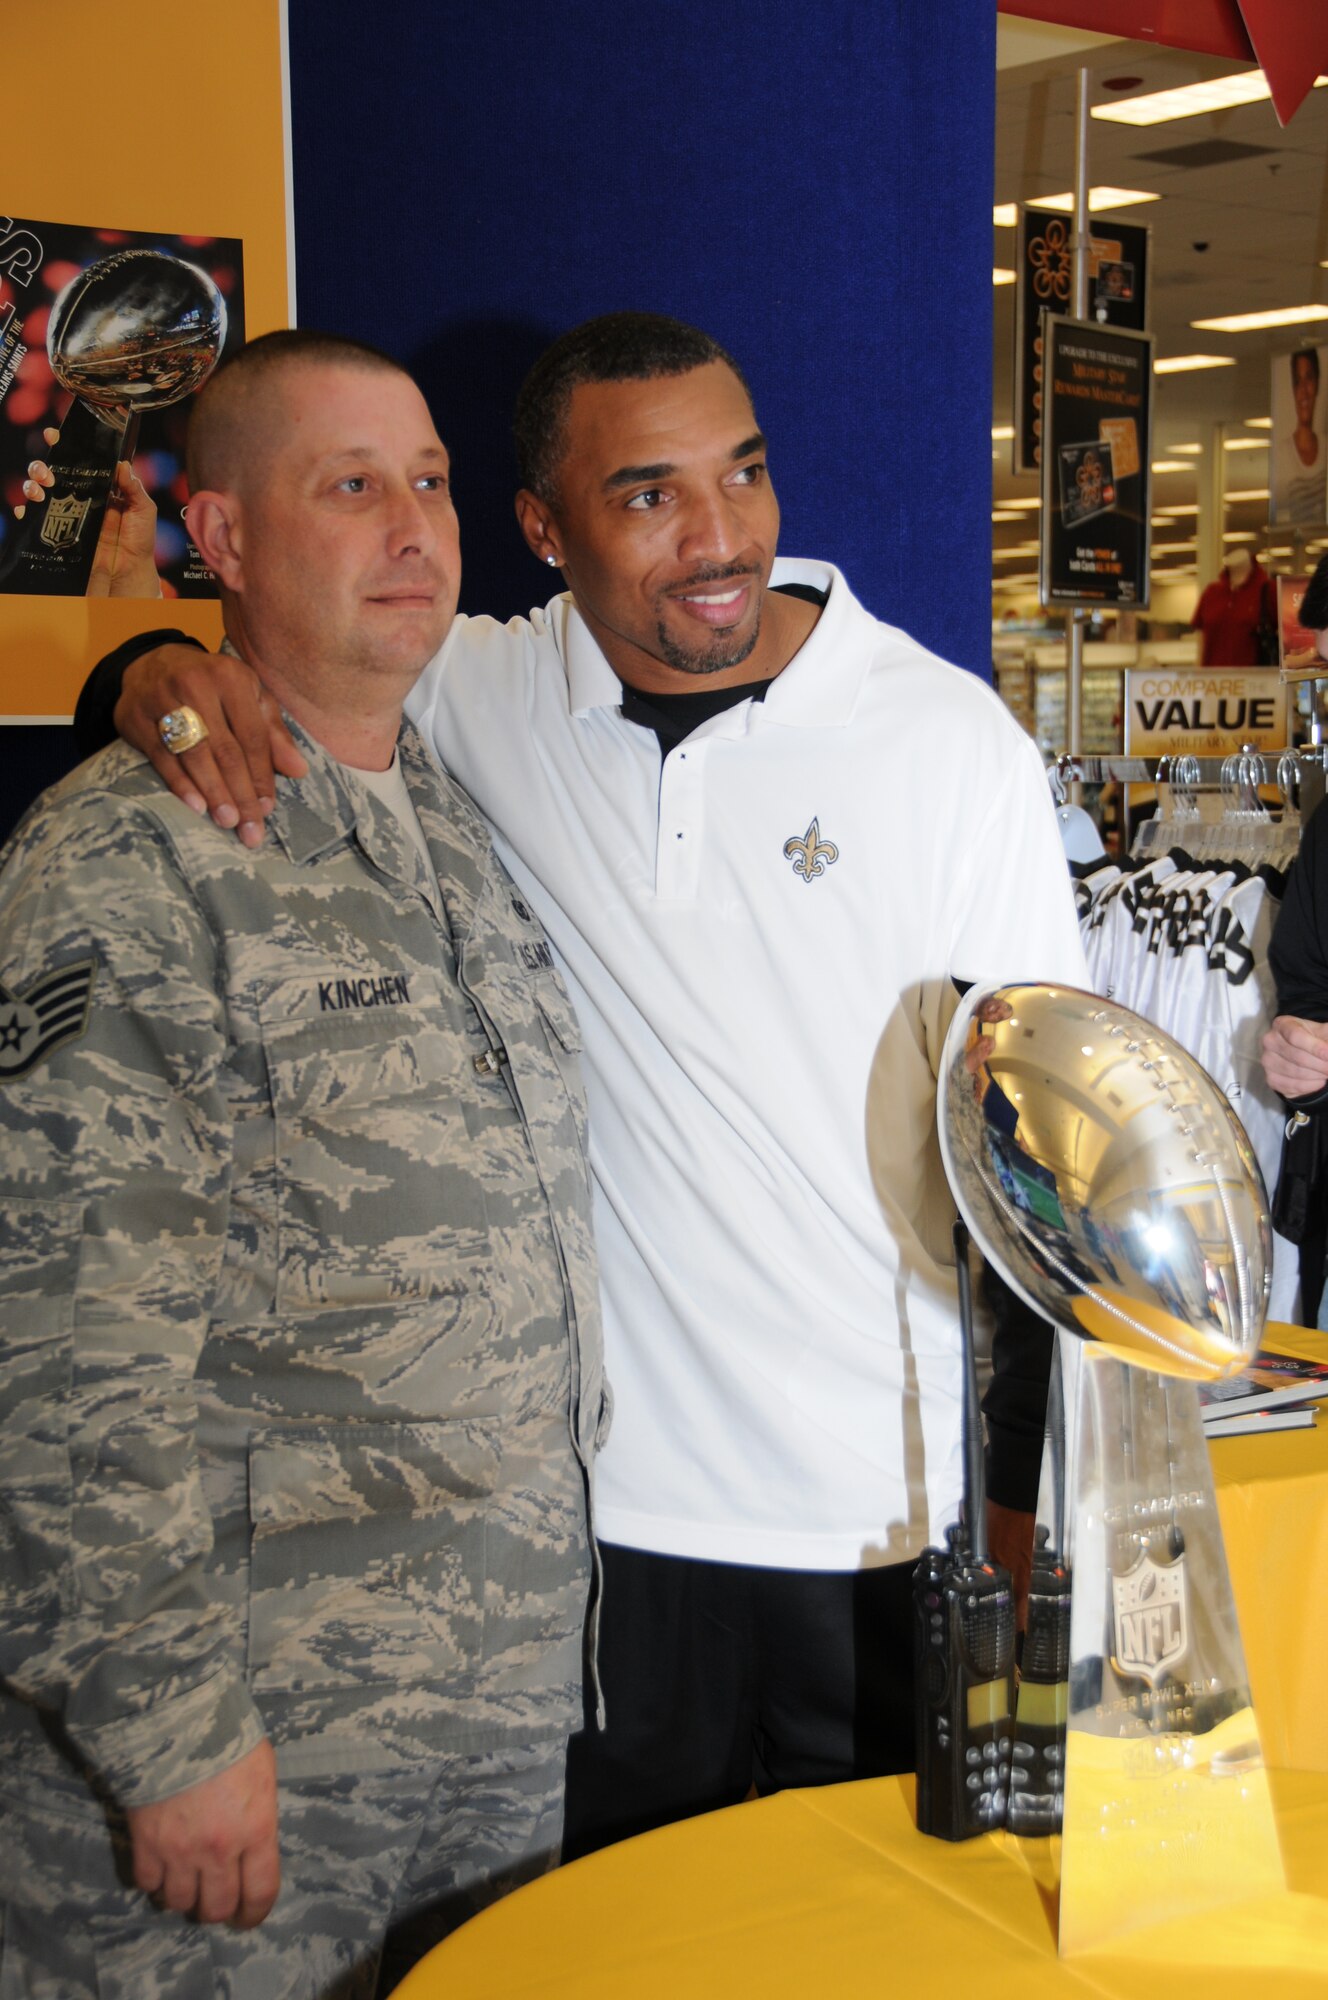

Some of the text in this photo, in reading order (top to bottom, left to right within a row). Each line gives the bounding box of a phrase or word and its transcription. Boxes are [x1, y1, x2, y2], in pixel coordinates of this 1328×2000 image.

[4, 333, 16, 347] OF
[10, 318, 25, 336] THE
[0, 343, 28, 404] LEANS SAINTS
[44, 516, 77, 542] NFL
[183, 571, 203, 580] Michael
[1142, 679, 1245, 697] COMPARE
[1135, 698, 1275, 731] VALUE
[1170, 735, 1229, 749] MILITARY
[318, 976, 411, 1011] KINCHEN
[1121, 1604, 1180, 1664] NFL
[1142, 1686, 1180, 1707] BOWL
[1166, 1706, 1192, 1723] NFC
